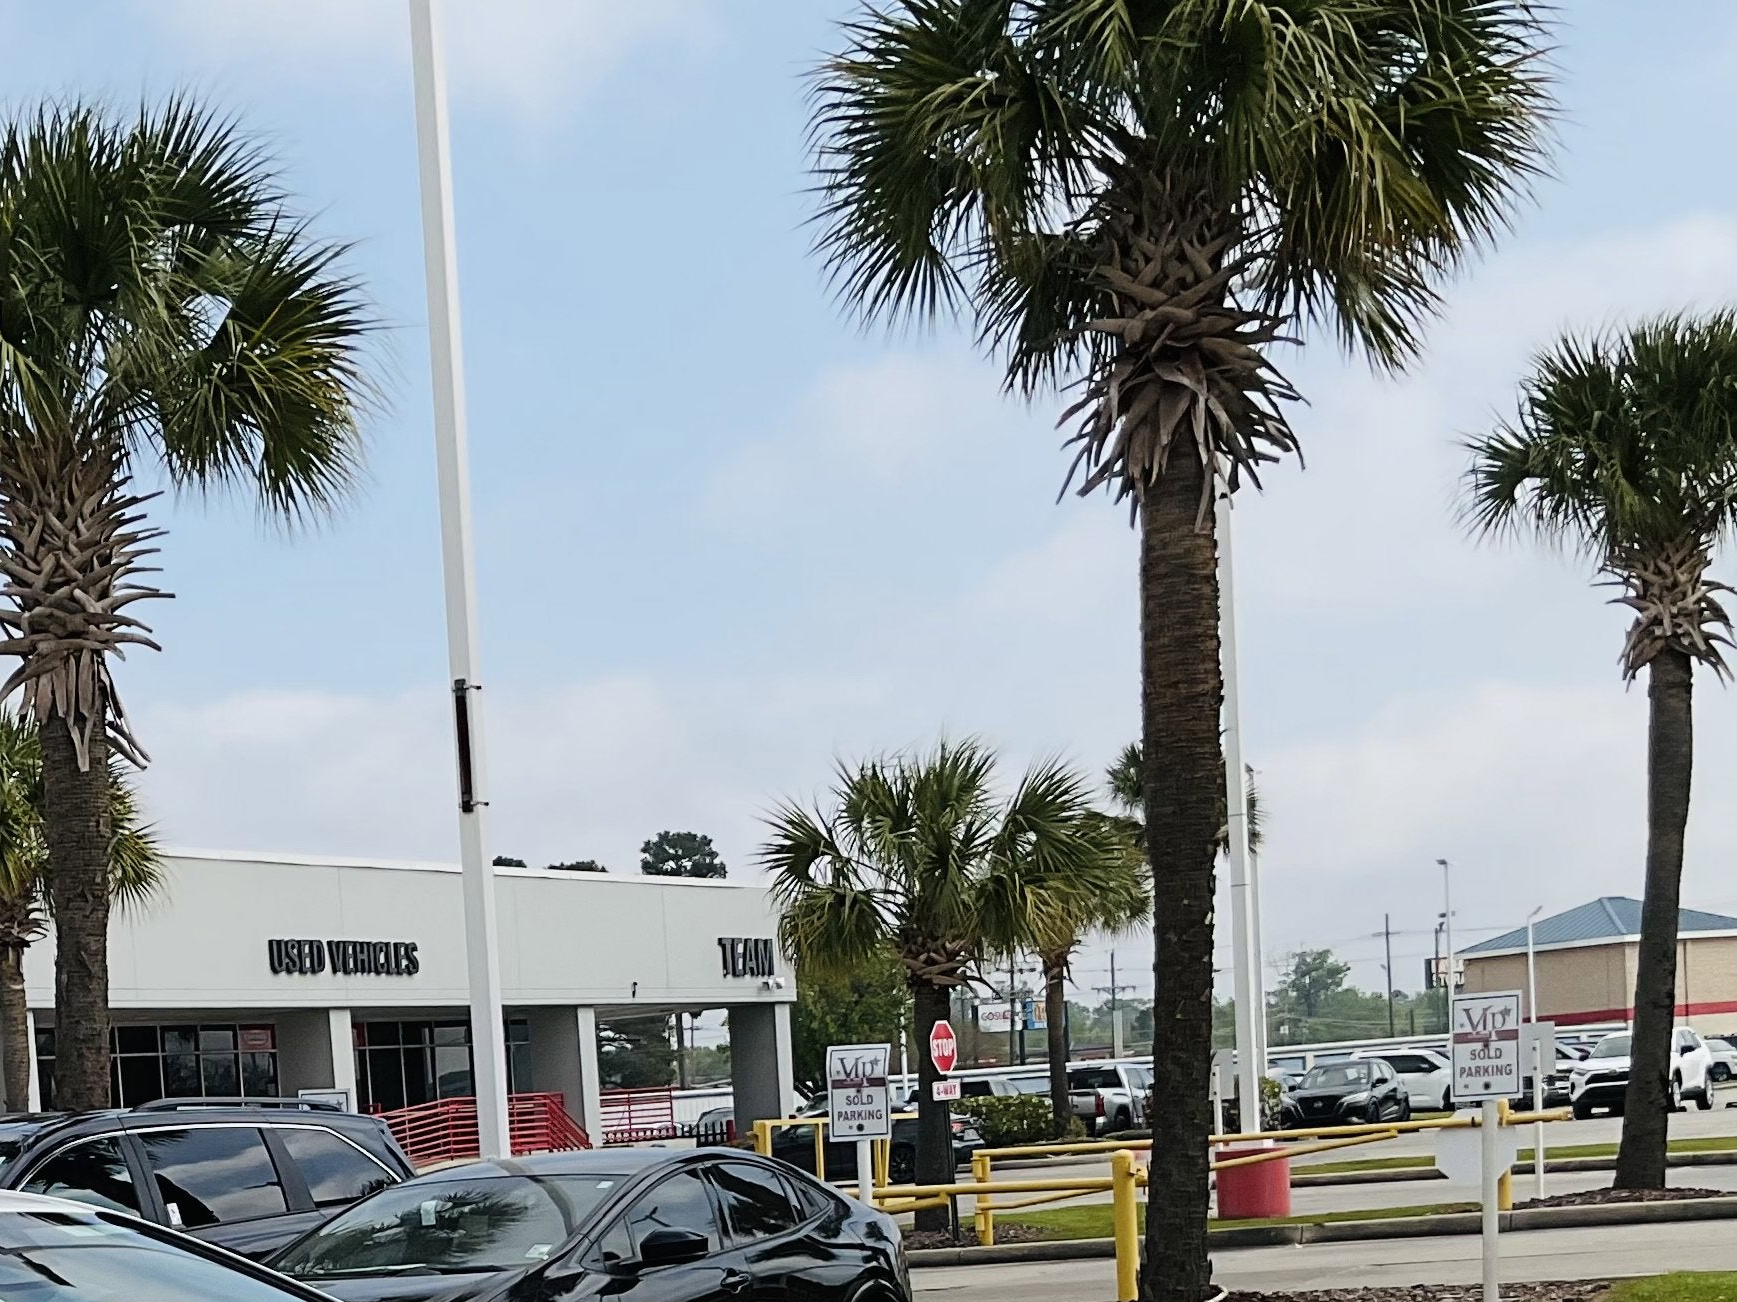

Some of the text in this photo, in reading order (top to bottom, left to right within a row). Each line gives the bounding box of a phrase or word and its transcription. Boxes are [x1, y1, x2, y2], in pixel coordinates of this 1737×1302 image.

[268, 939, 420, 976] USED VEHICLES
[717, 937, 774, 978] TEAM
[932, 1038, 954, 1057] STOP
[1470, 1047, 1503, 1061] SOLD
[1459, 1063, 1513, 1078] PARKING
[845, 1094, 874, 1106] SOLD
[837, 1108, 883, 1121] PARKING
